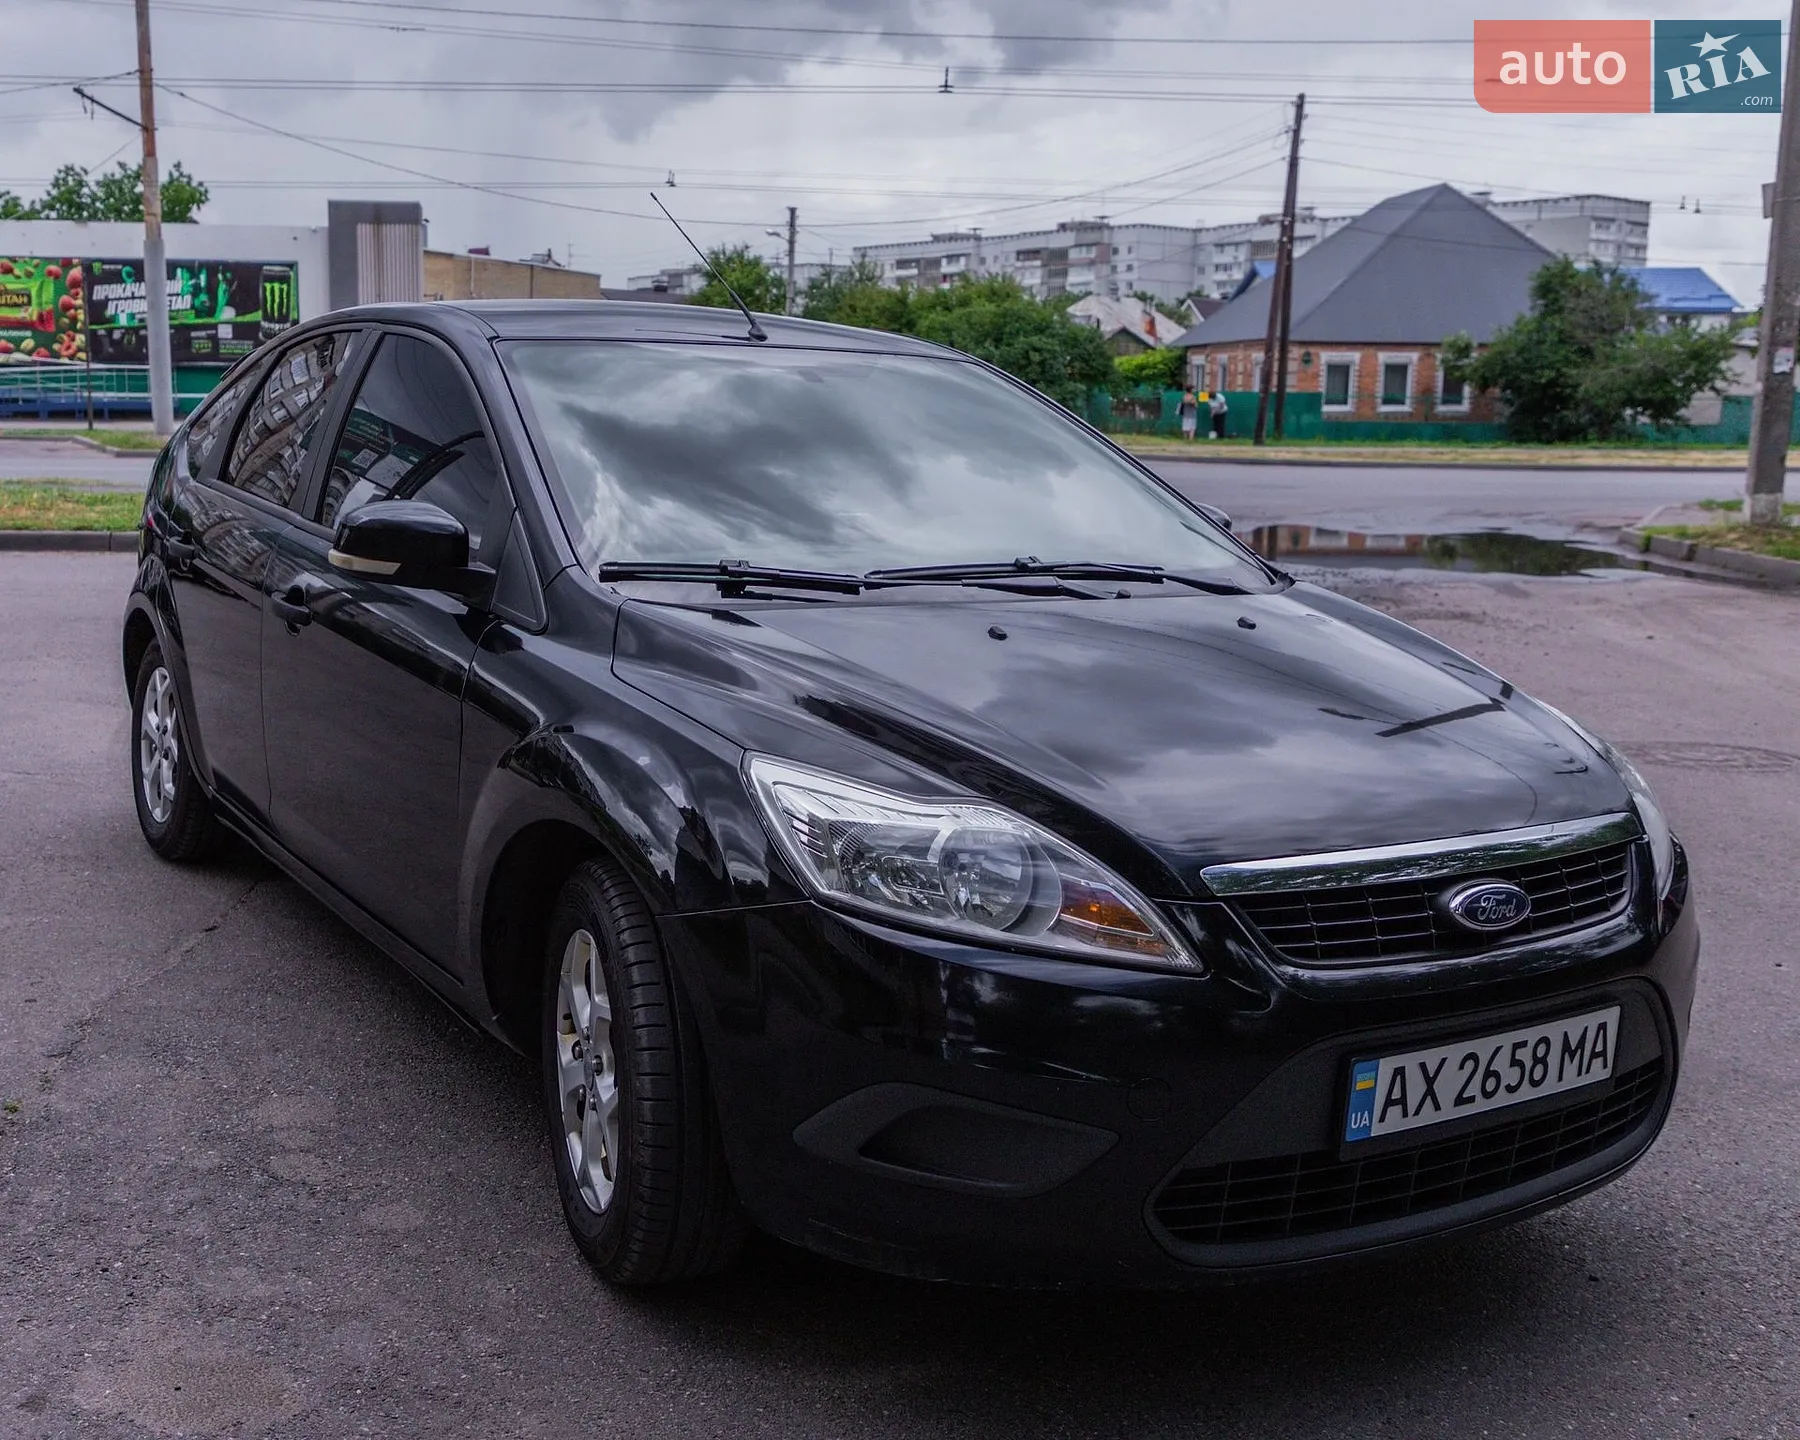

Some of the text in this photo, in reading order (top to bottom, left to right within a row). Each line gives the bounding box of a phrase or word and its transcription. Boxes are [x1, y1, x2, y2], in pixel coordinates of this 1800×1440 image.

[92, 281, 146, 300] ПРОКАЧА
[107, 298, 148, 315] ІГРОВИ
[1470, 894, 1516, 920] Ford
[1378, 1020, 1609, 1123] AX 2658 MA
[1351, 1111, 1370, 1129] UA
